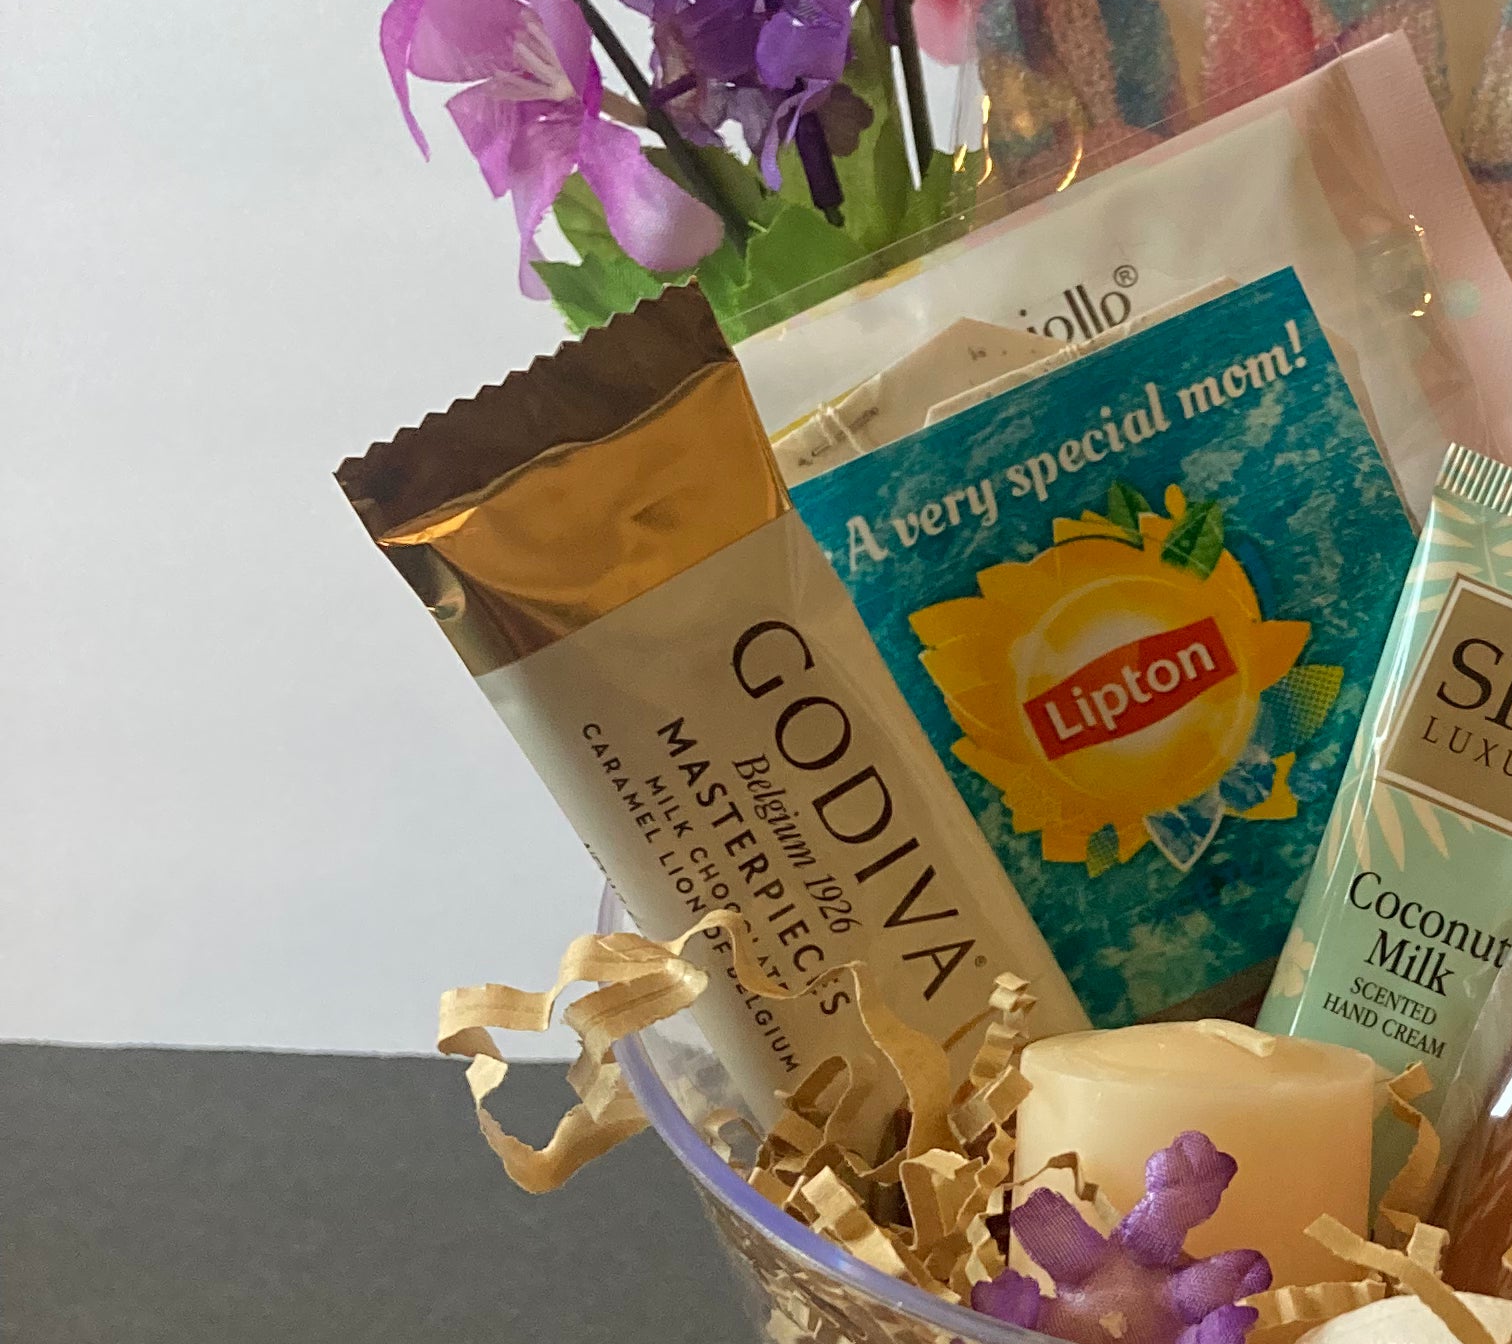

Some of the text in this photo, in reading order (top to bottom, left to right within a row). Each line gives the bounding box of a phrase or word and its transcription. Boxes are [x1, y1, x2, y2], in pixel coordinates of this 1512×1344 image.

[847, 319, 1307, 572] A very special mom!
[1045, 641, 1216, 741] Lipton
[582, 722, 662, 843] CARAMEL
[659, 851, 707, 913] LION
[644, 775, 694, 838] MILK
[732, 754, 862, 933] Belgium 1926
[1350, 871, 1512, 969] Coconut
[1364, 928, 1455, 997] Milk
[1323, 992, 1448, 1058] HAND CREAM
[1350, 976, 1438, 1026] SCENTED
